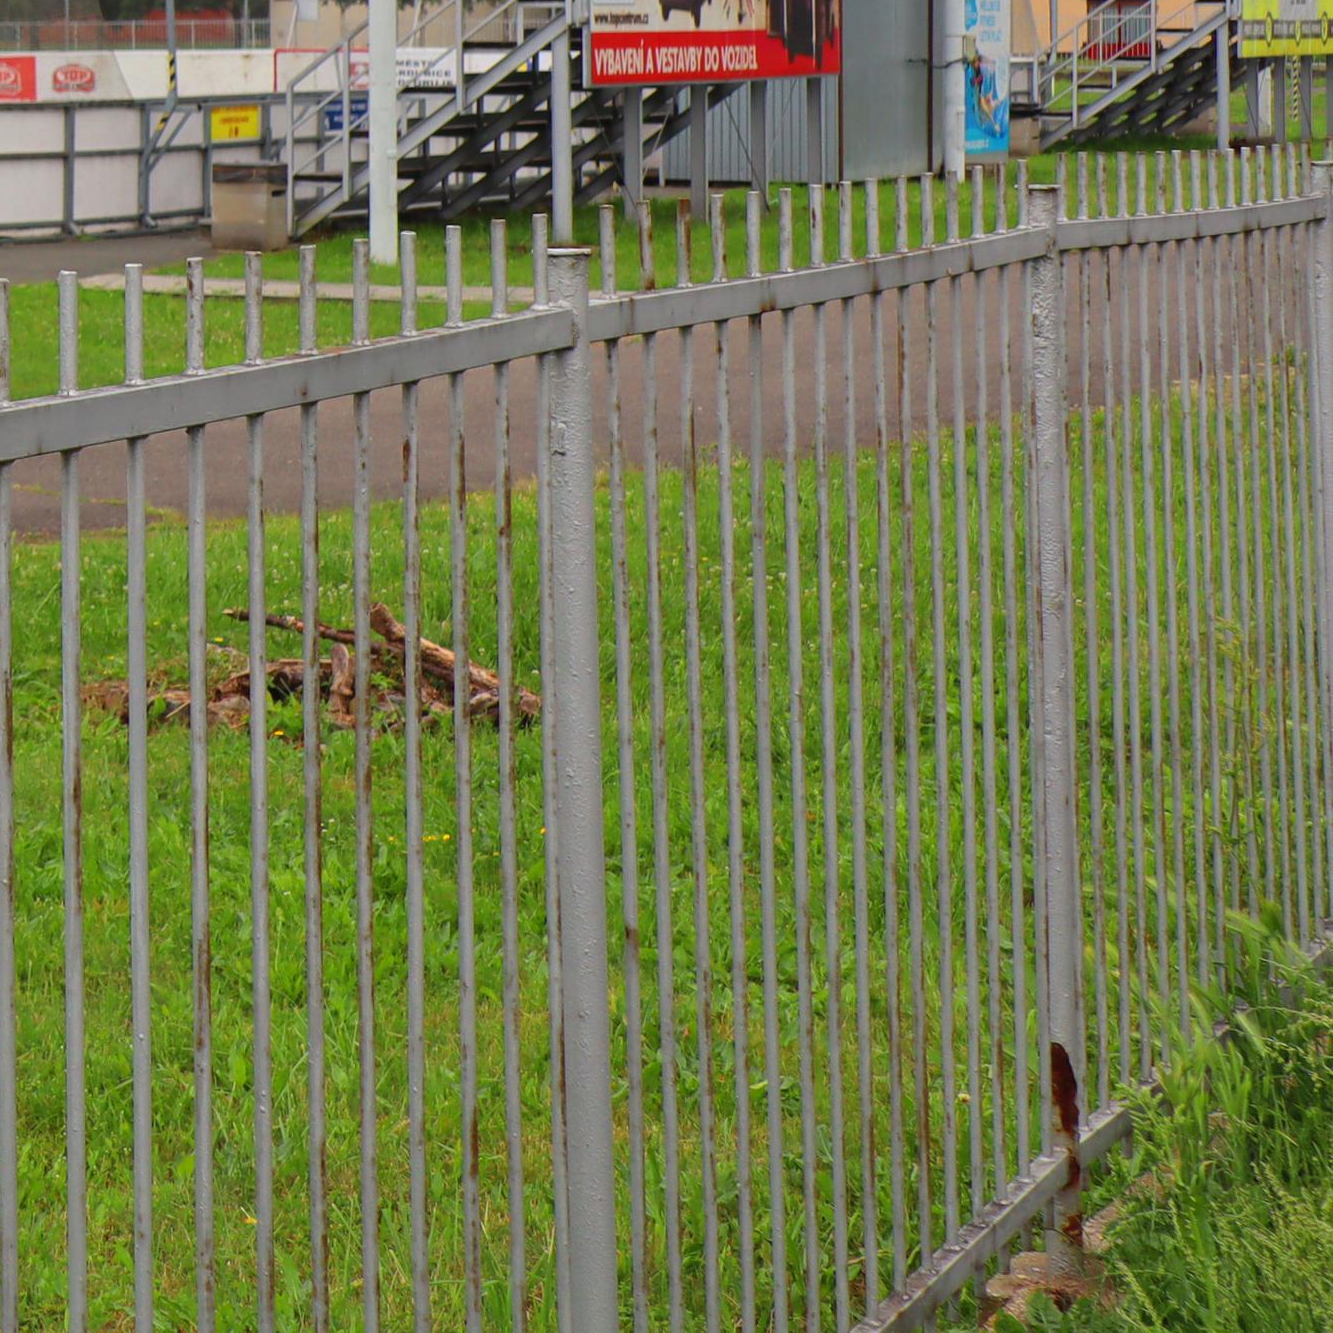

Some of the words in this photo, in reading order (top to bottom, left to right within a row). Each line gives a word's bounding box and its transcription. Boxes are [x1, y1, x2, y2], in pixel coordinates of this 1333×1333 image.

[594, 38, 645, 76] VYBAVENÍ
[645, 47, 654, 74] A
[655, 46, 703, 74] VESTAVBY
[704, 46, 720, 73] DO
[721, 44, 758, 71] VOZIDEL
